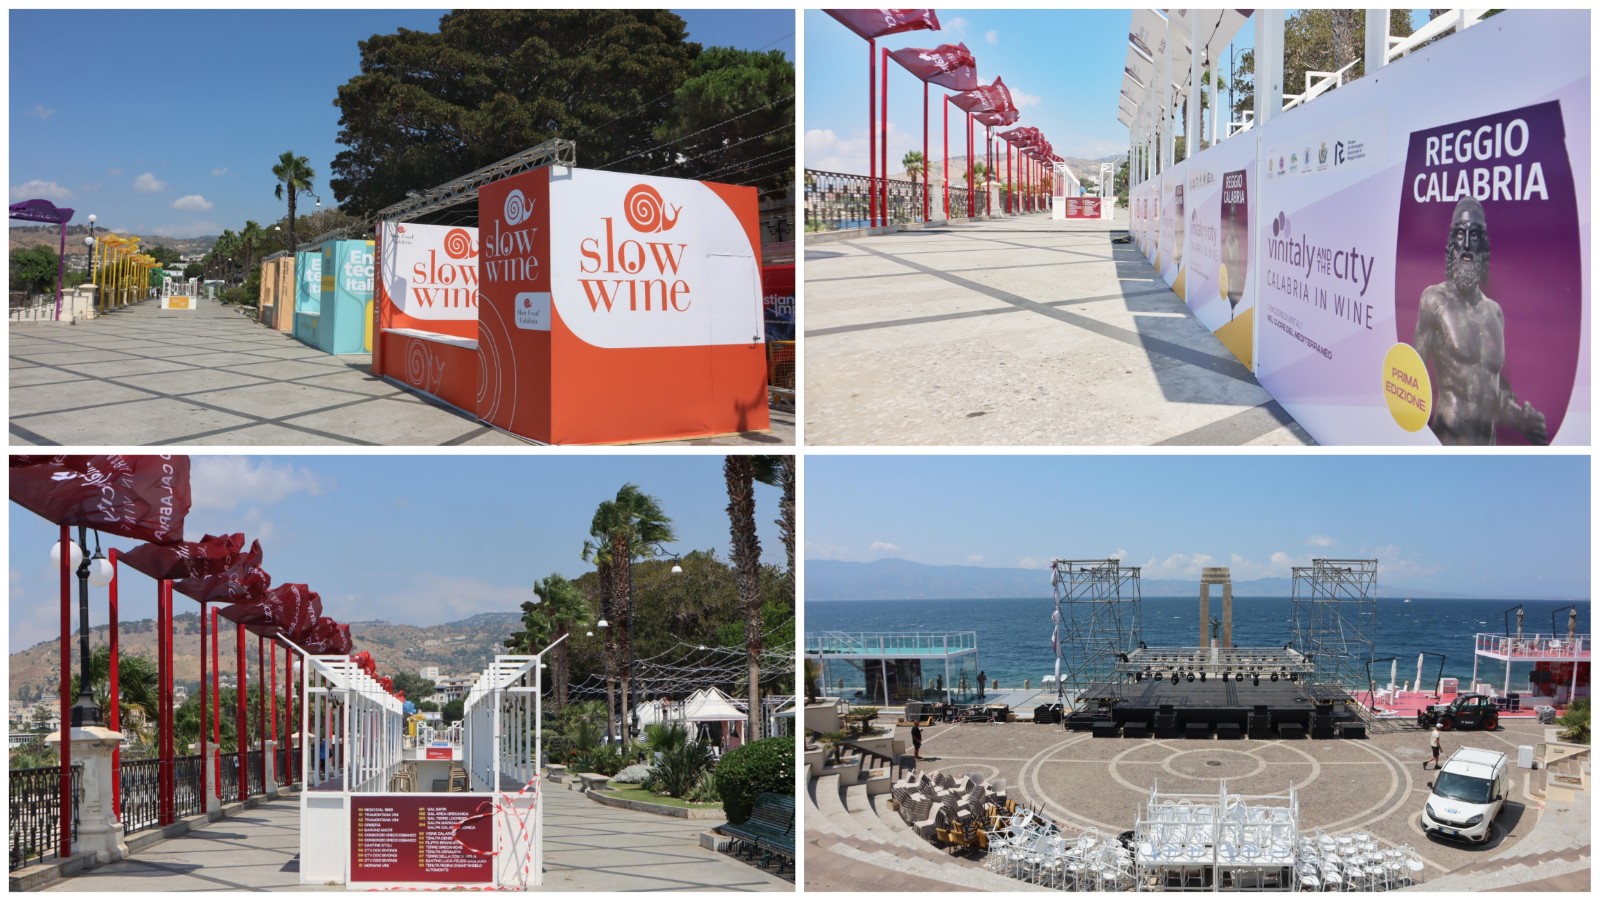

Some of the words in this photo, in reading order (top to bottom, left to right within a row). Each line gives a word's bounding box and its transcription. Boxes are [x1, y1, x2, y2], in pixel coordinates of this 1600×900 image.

[1425, 118, 1530, 167] REGGIO
[1224, 190, 1244, 204] CALABRIA
[1226, 174, 1242, 188] REGGIO
[1413, 162, 1550, 203] CALABRIA
[485, 219, 538, 258] slow
[580, 217, 687, 275] slow
[412, 249, 479, 286] slow
[485, 255, 539, 282] wine
[1268, 234, 1316, 279] vinitaly
[1316, 248, 1332, 262] AND
[1333, 246, 1374, 296] city
[1316, 260, 1331, 276] THE
[411, 288, 479, 309] wine
[578, 279, 692, 312] wine
[1266, 270, 1310, 302] CALABRIA
[1314, 286, 1327, 310] IN
[1334, 293, 1374, 330] WINE
[1392, 367, 1419, 390] PRIMA
[1386, 380, 1426, 412] EDIZIONE
